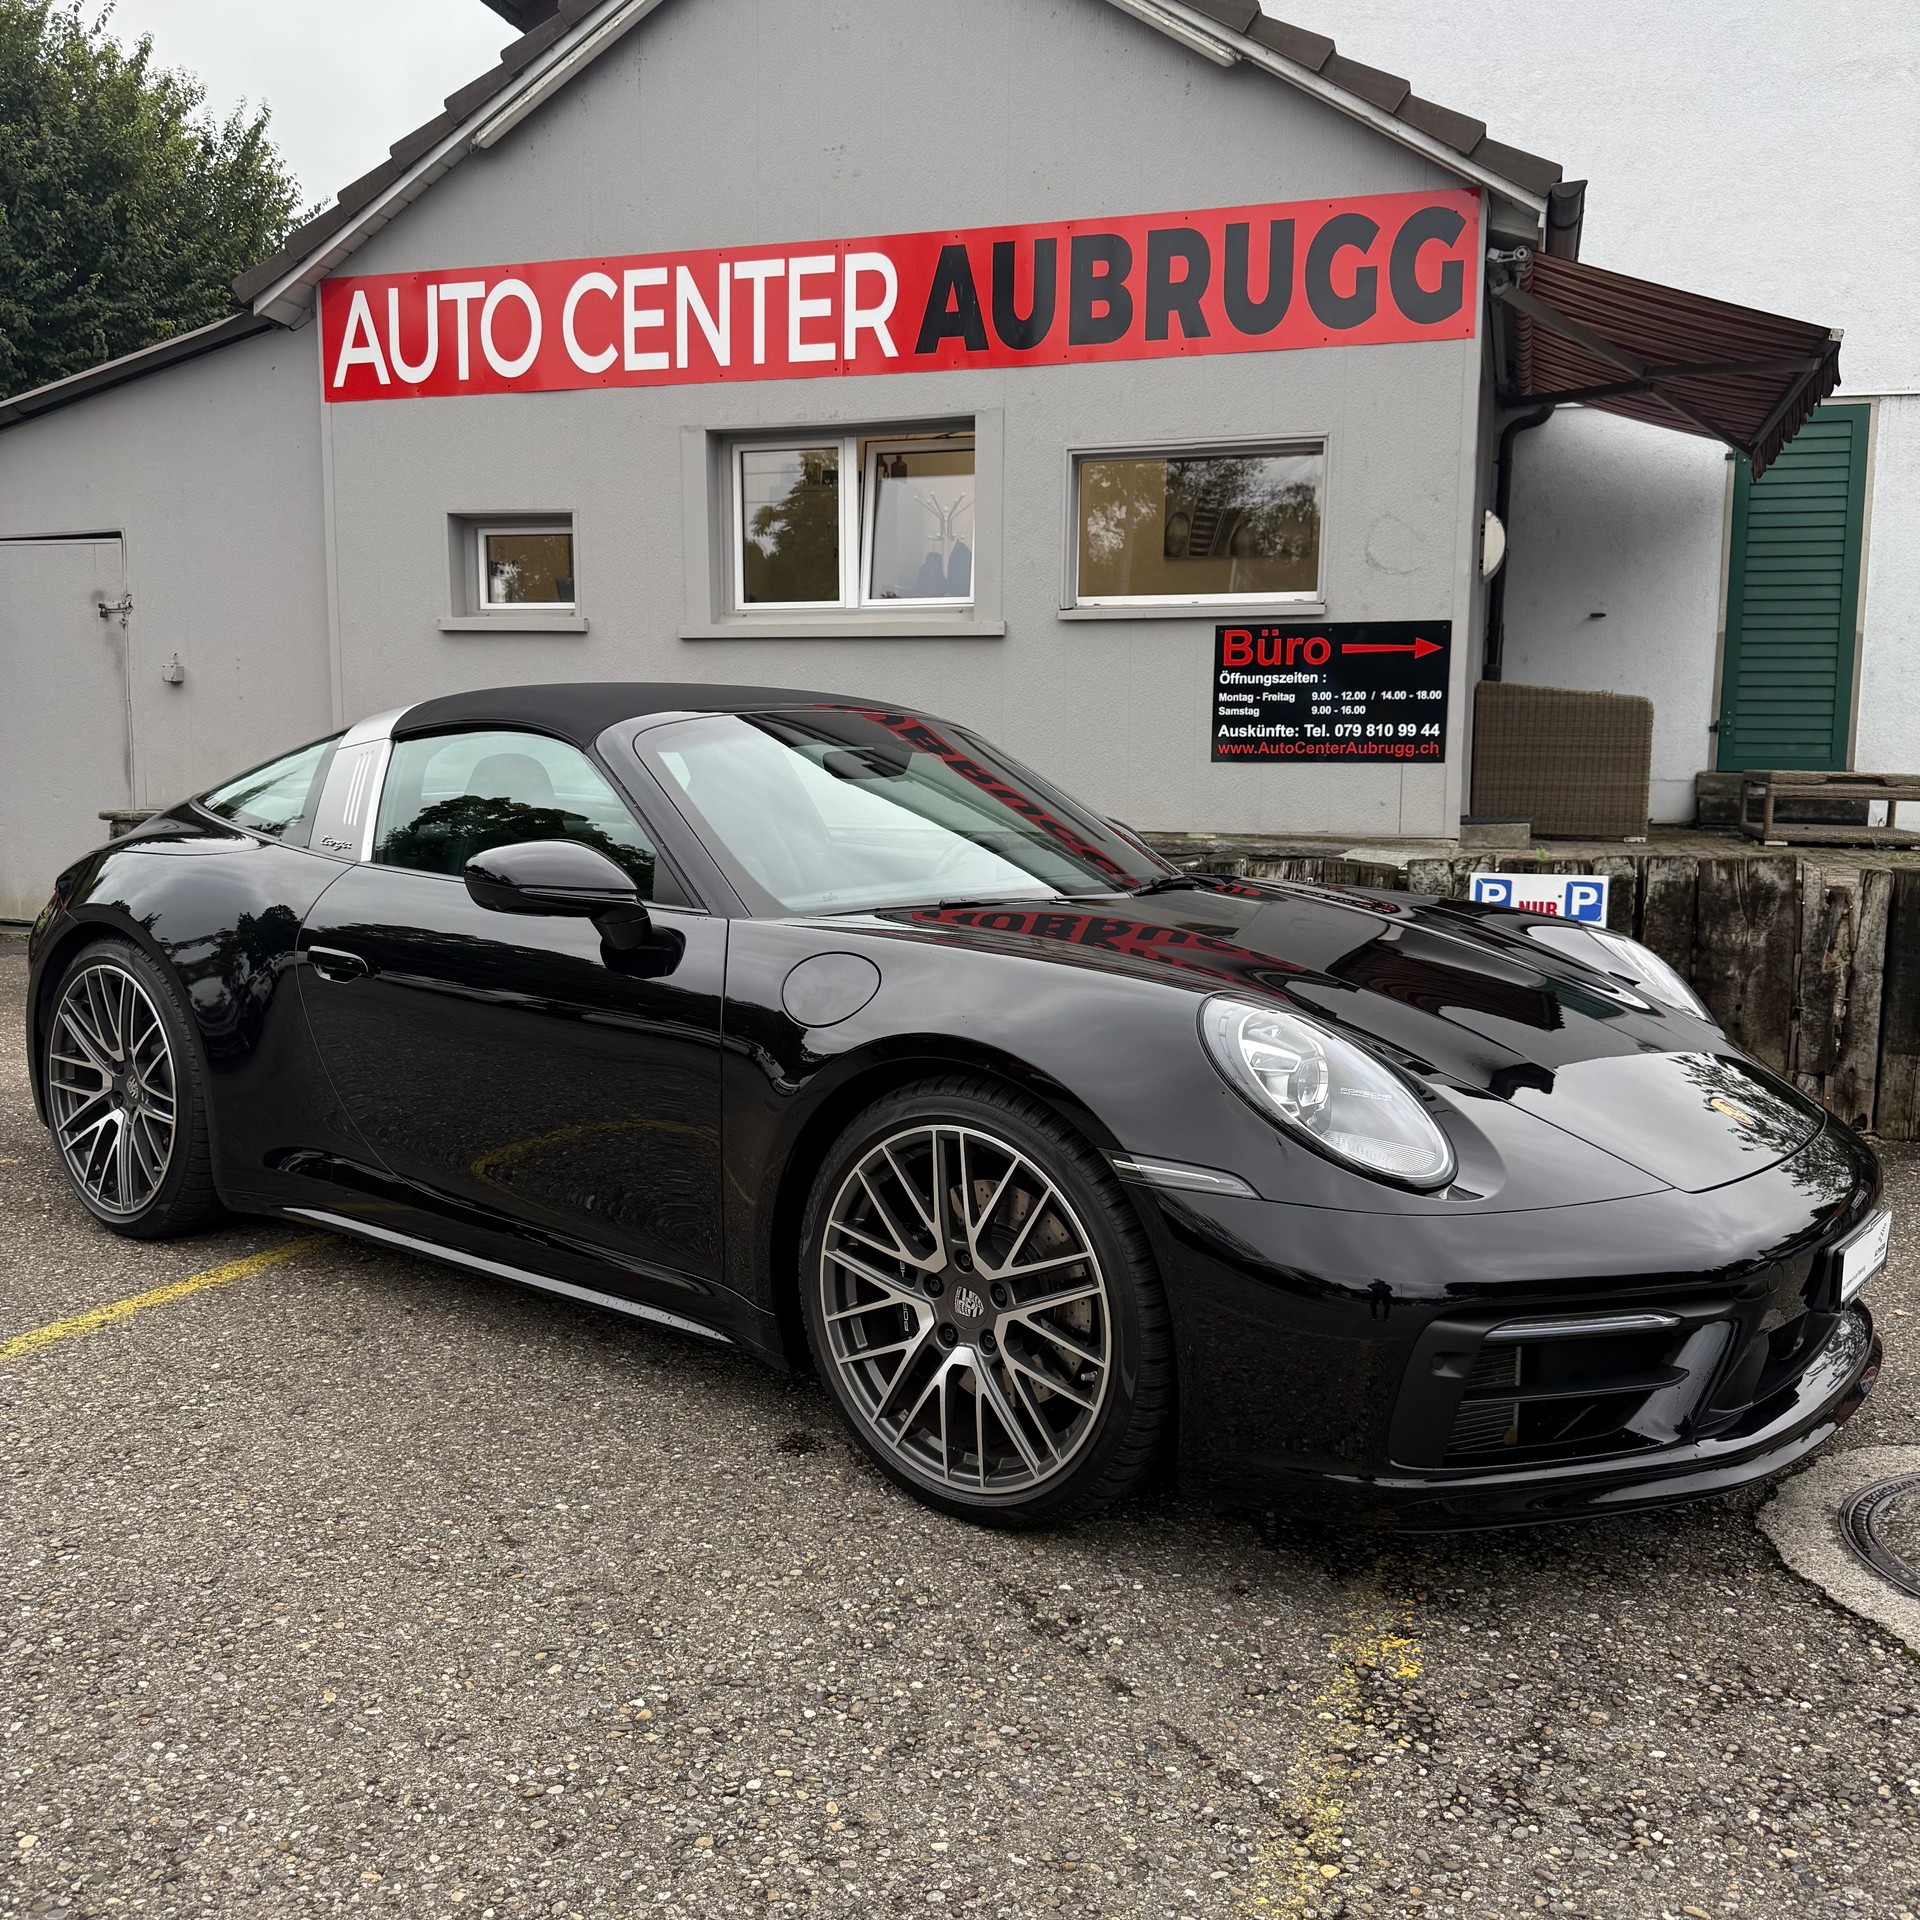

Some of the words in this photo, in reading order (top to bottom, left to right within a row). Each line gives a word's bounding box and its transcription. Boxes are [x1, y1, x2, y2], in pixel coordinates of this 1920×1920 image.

[333, 278, 543, 388] AUTO
[562, 251, 899, 374] CENTER
[914, 206, 1468, 355] AUBRUGG
[1222, 628, 1331, 667] Büro
[1219, 670, 1319, 687] Öffnungszeiten
[1218, 692, 1254, 704] Montag
[1262, 692, 1296, 704] Freitag
[1311, 691, 1333, 701] 9.00
[1340, 691, 1367, 701] 12.00
[1380, 690, 1407, 701] 14.00
[1415, 690, 1443, 700] 18.00
[1218, 706, 1260, 718] Samstag
[1311, 705, 1332, 715] 9.00
[1340, 705, 1367, 715] 16.00
[1218, 723, 1300, 738] Auskünfte:
[1303, 724, 1330, 738] Tel.
[1334, 723, 1362, 738] 079
[1366, 723, 1394, 738] 810
[1397, 723, 1417, 737] 99
[1420, 722, 1441, 737] 44
[1217, 741, 1440, 758] www.AutoCenterAubrugg.ch
[1481, 883, 1507, 903] P
[1570, 886, 1598, 915] P
